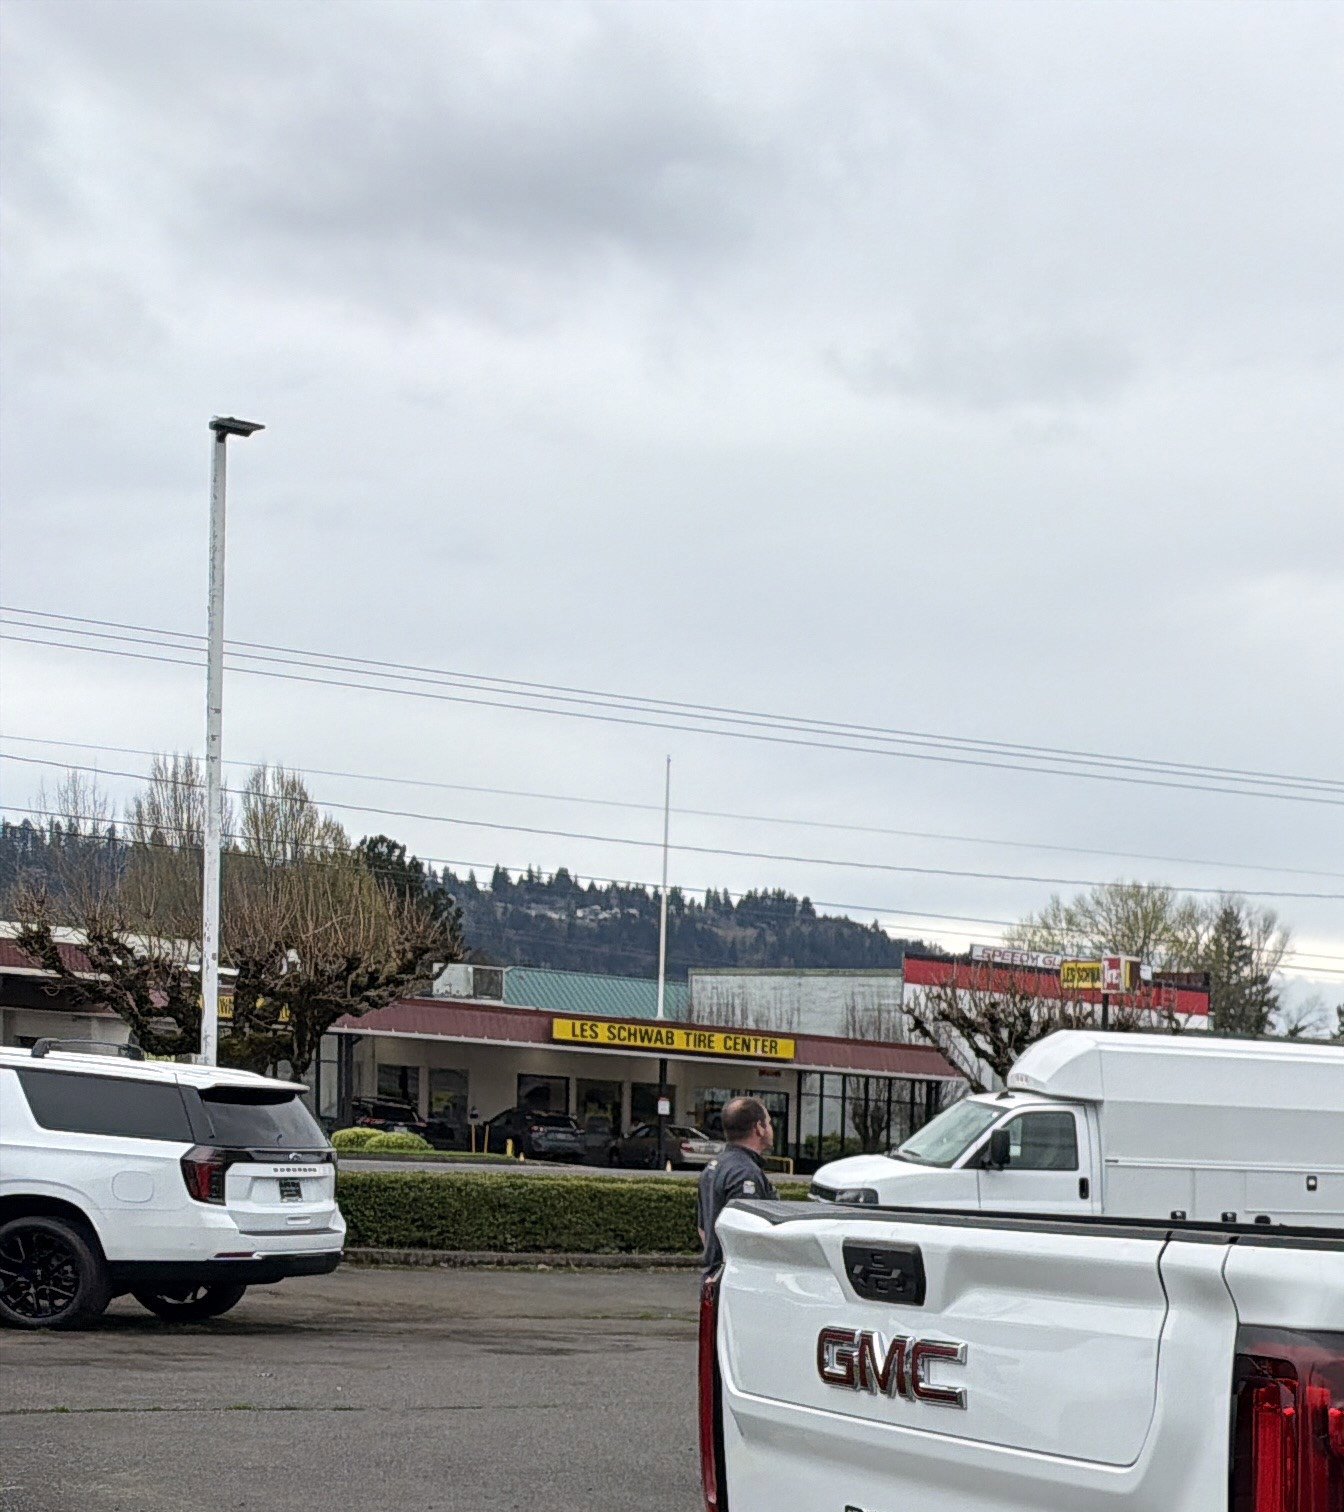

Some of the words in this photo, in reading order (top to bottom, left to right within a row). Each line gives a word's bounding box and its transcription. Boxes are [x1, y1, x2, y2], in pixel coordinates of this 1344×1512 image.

[571, 1022, 599, 1039] LES
[607, 1024, 675, 1046] SCHWAB
[684, 1031, 715, 1050] TIRE
[723, 1035, 779, 1055] CENTER
[817, 1325, 968, 1410] GMC
